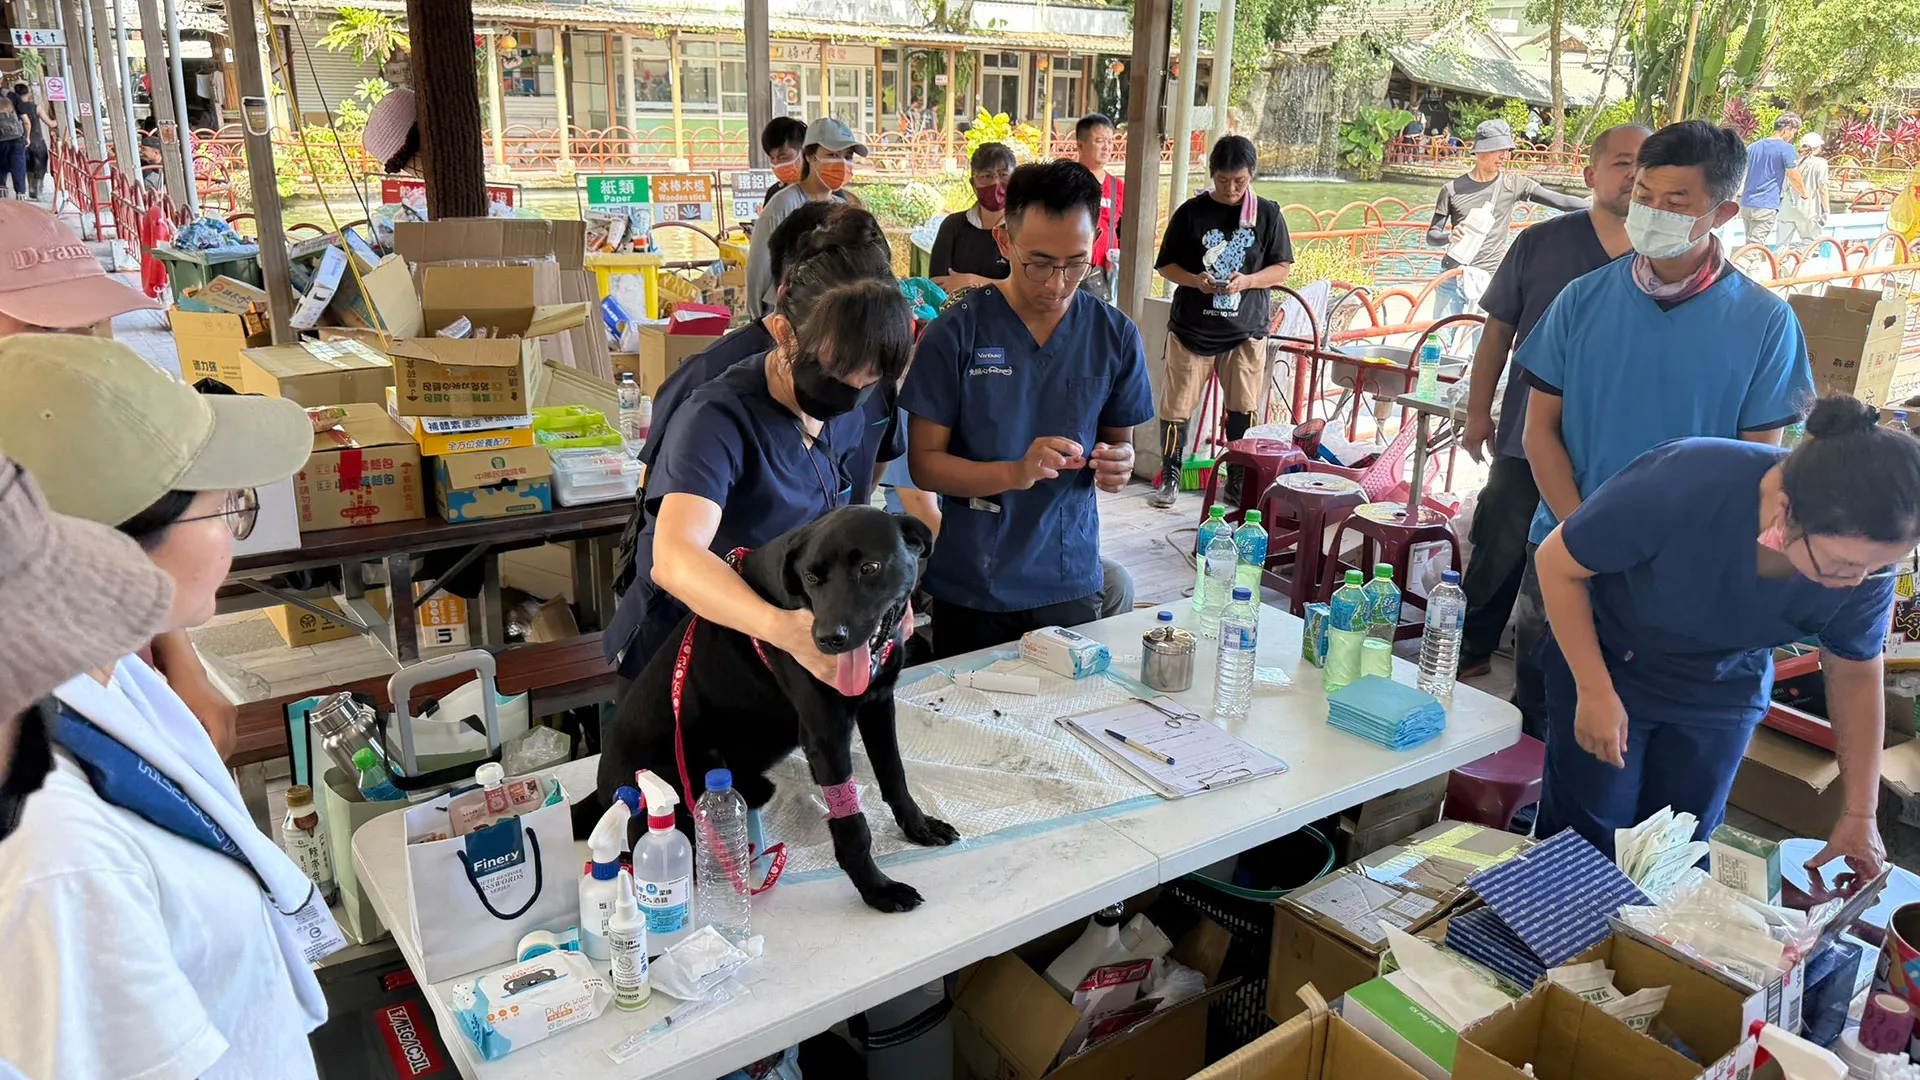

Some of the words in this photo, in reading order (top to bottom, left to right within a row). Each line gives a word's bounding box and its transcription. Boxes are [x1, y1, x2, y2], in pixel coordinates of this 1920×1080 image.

[601, 180, 635, 195] 紙類
[658, 180, 705, 193] 冰棒木棍
[603, 195, 631, 203] Paper
[448, 437, 512, 450] 全方位營養配方
[473, 850, 520, 872] Finery
[481, 873, 524, 892] ASSWORDS
